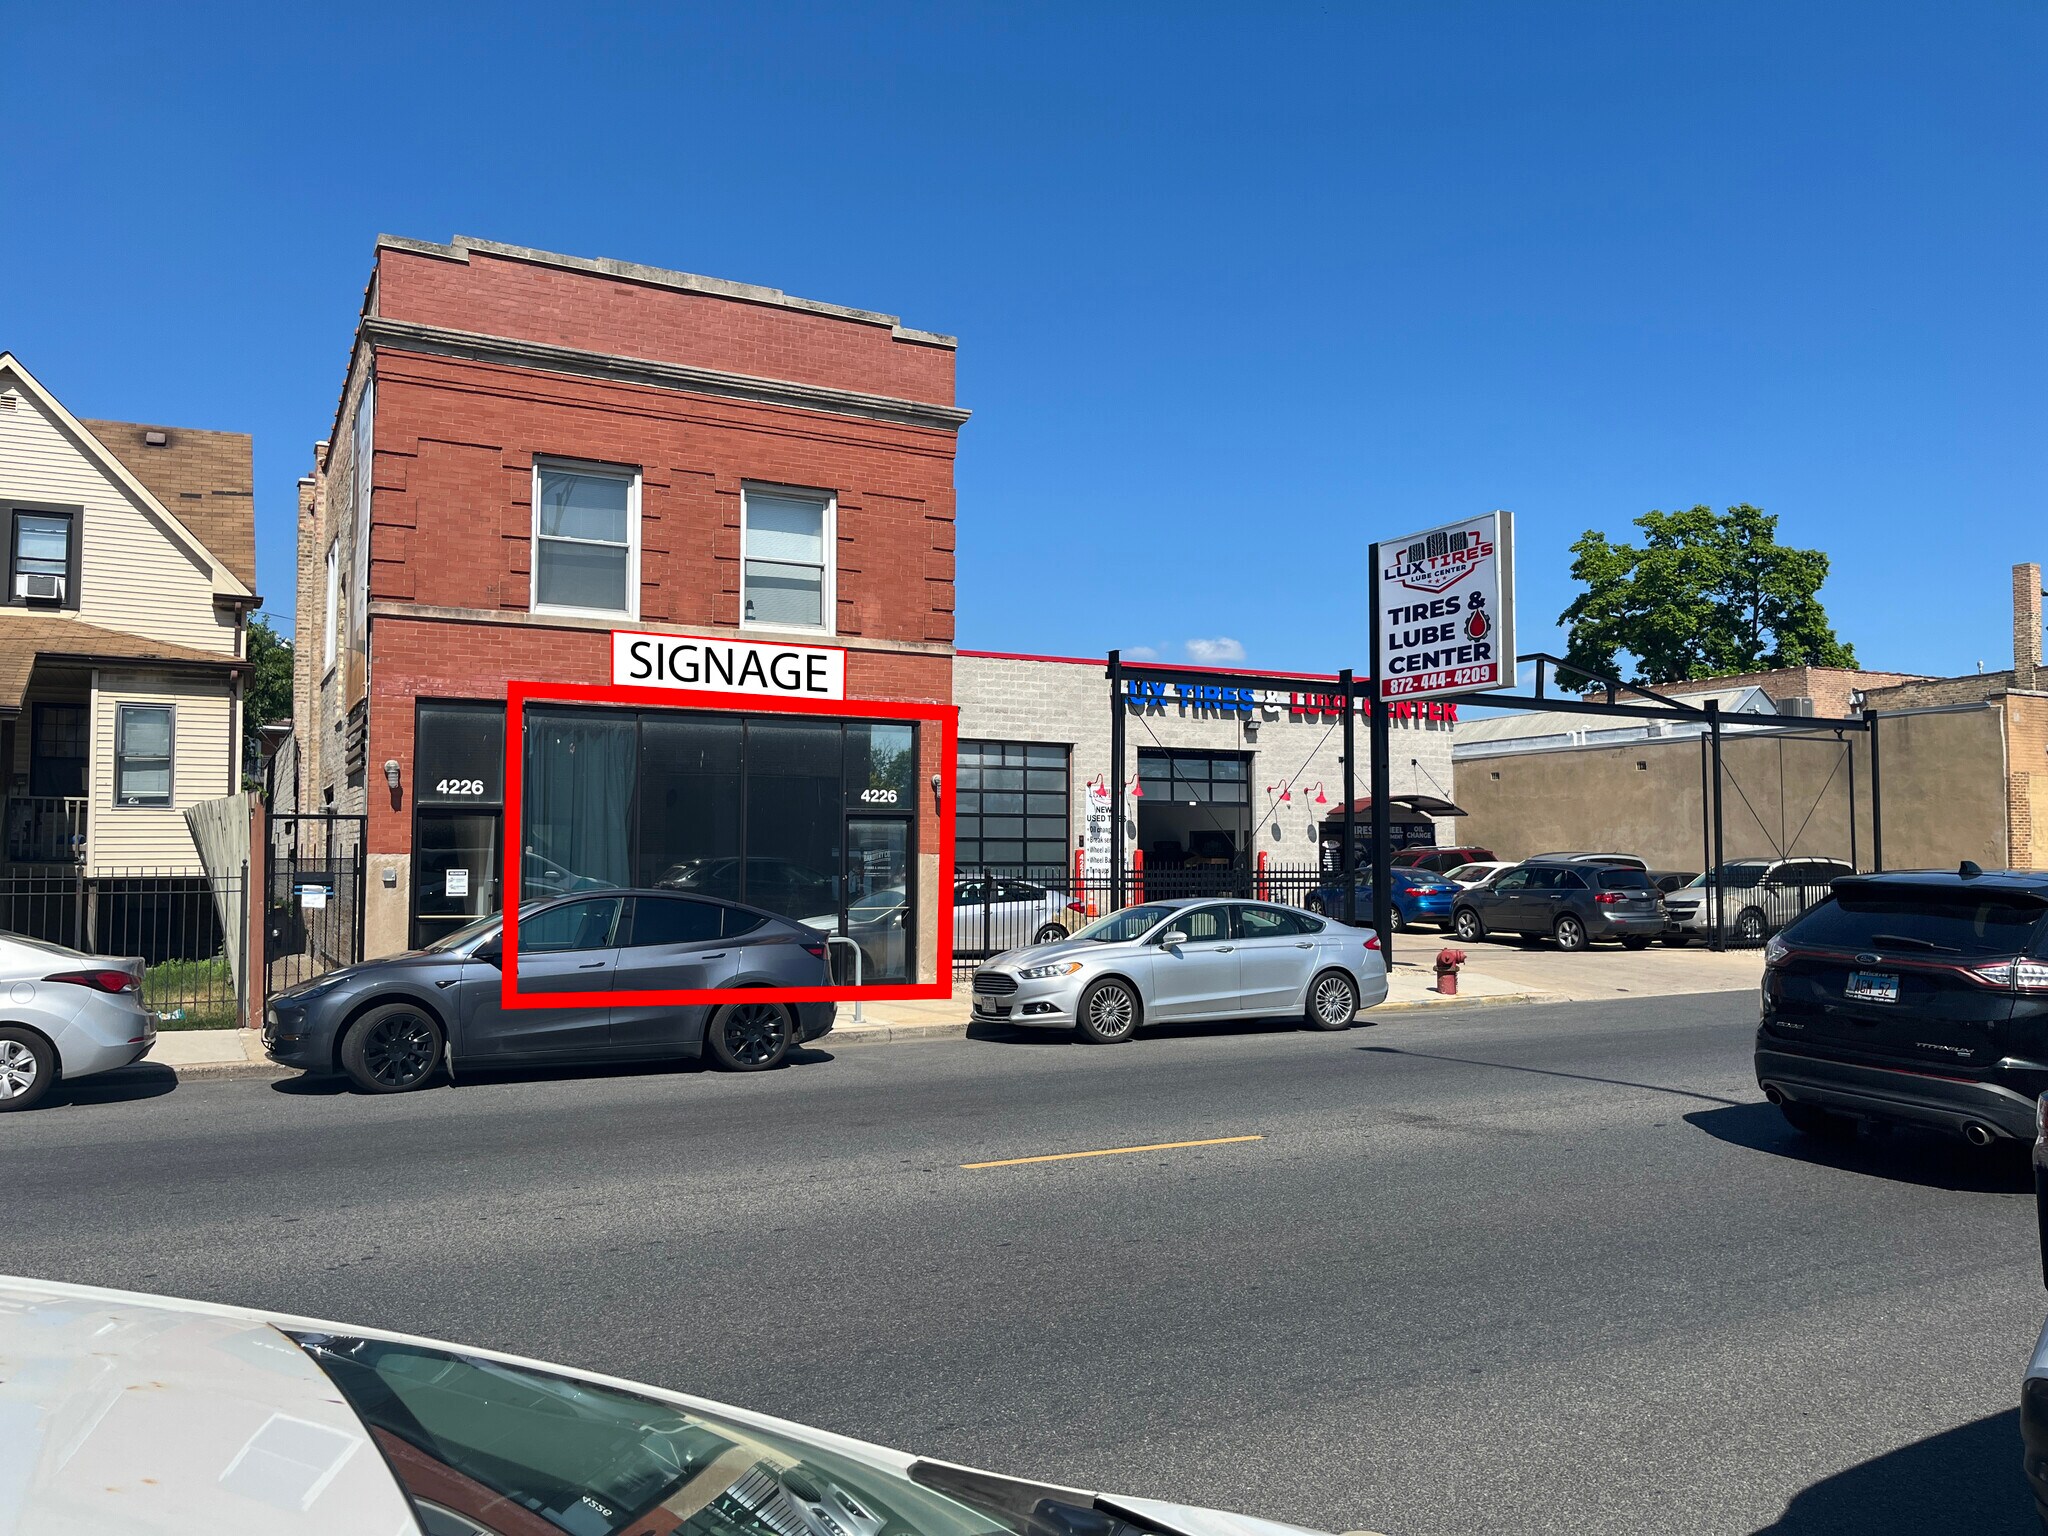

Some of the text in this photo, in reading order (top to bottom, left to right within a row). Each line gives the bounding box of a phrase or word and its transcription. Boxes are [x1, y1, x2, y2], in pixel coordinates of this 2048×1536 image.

[1384, 543, 1493, 580] LUX TIRES
[1411, 564, 1467, 582] LUBE CENTER
[1387, 590, 1486, 626] TIRES &
[1389, 622, 1456, 650] LUBE
[1388, 642, 1491, 674] CENTER
[1390, 665, 1490, 694] 872- 444- 4209
[1125, 680, 1168, 706] UX
[1175, 683, 1255, 711] TIRES
[1264, 690, 1283, 713] &
[436, 779, 484, 795] 4226
[860, 789, 898, 803] 4226
[1086, 814, 1106, 822] USED
[1413, 825, 1425, 833] OIL
[1915, 1042, 1976, 1053] TITANIUM
